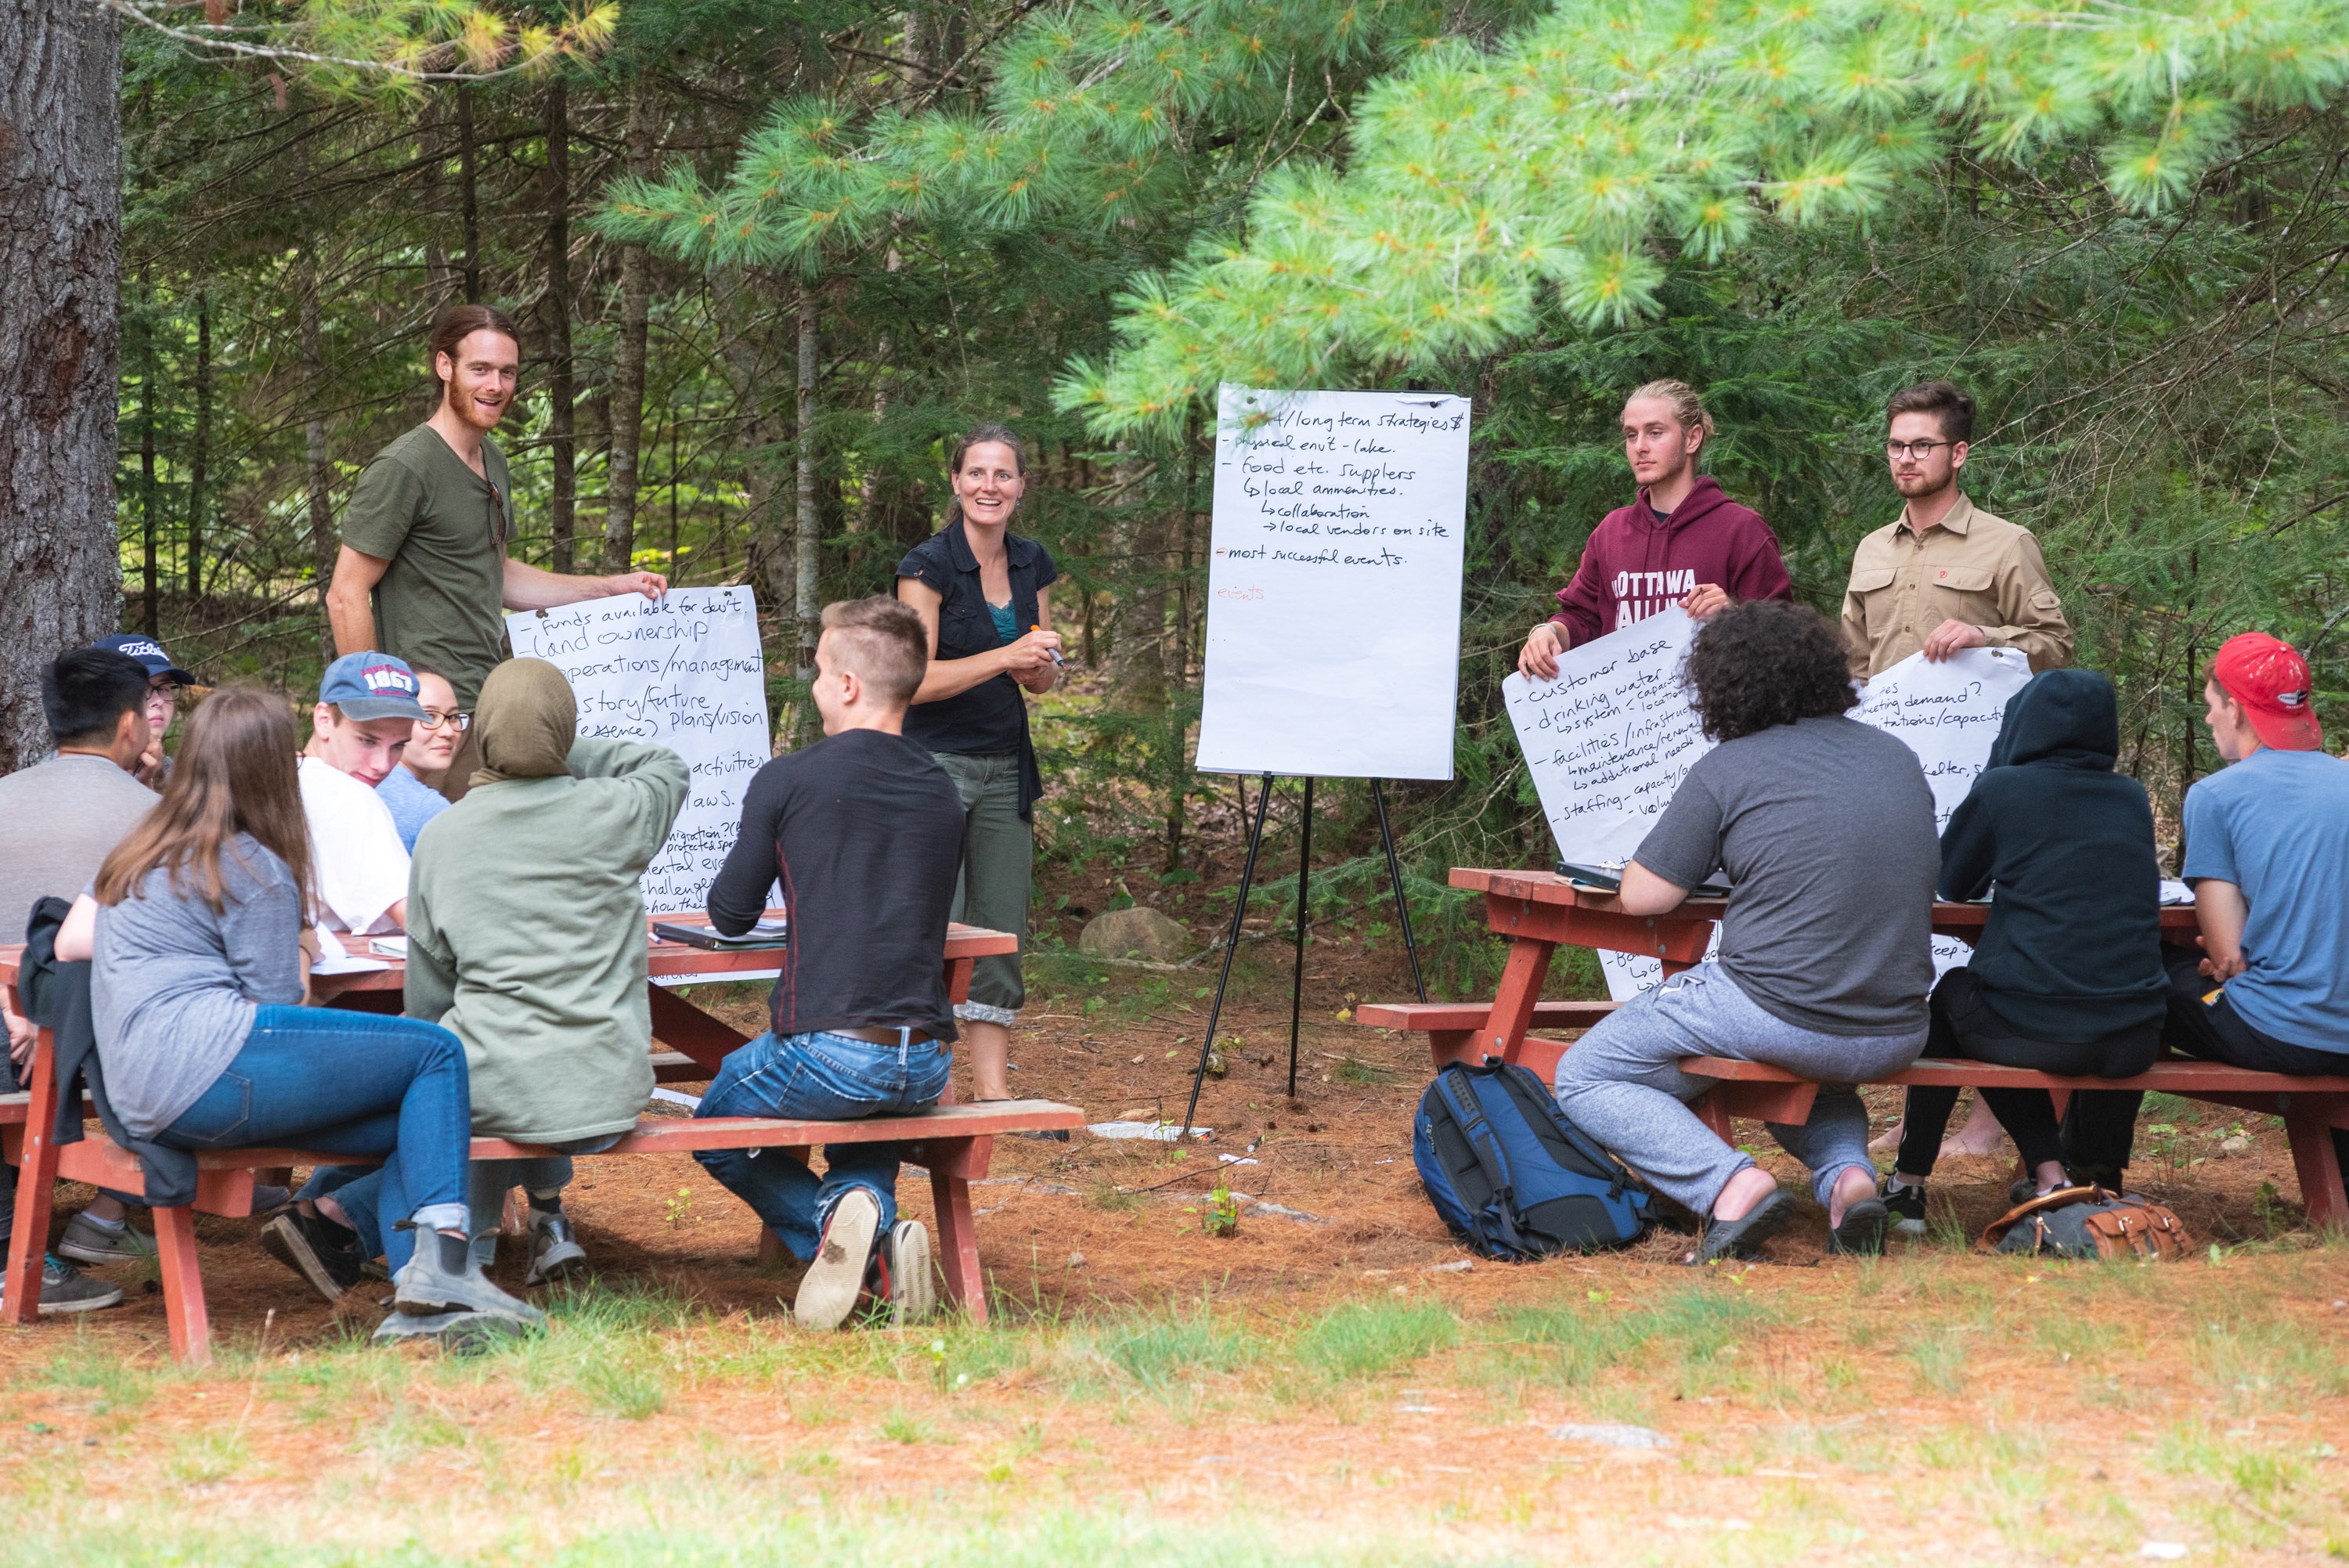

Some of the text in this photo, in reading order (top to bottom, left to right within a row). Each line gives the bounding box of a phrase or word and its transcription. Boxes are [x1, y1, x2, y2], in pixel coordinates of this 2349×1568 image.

[1338, 412, 1370, 427] term
[1294, 460, 1329, 474] etc.
[1265, 480, 1303, 496] local
[1278, 503, 1370, 519] collaboration
[1280, 521, 1320, 535] local
[1326, 522, 1387, 535] vendors
[1419, 520, 1450, 538] site
[1229, 544, 1408, 567] most successful events.
[1611, 569, 1696, 599] OTTAWA
[678, 596, 698, 616] for
[597, 618, 709, 644] ownership
[118, 640, 170, 661] Titlei
[363, 670, 412, 693] 1867
[1528, 640, 1673, 702] customer base
[1539, 668, 1662, 729] drinking water
[1575, 706, 1621, 729] system
[1552, 706, 1690, 767] facilities/infrastruc
[1564, 794, 1622, 820] staffing
[651, 899, 677, 914] how
